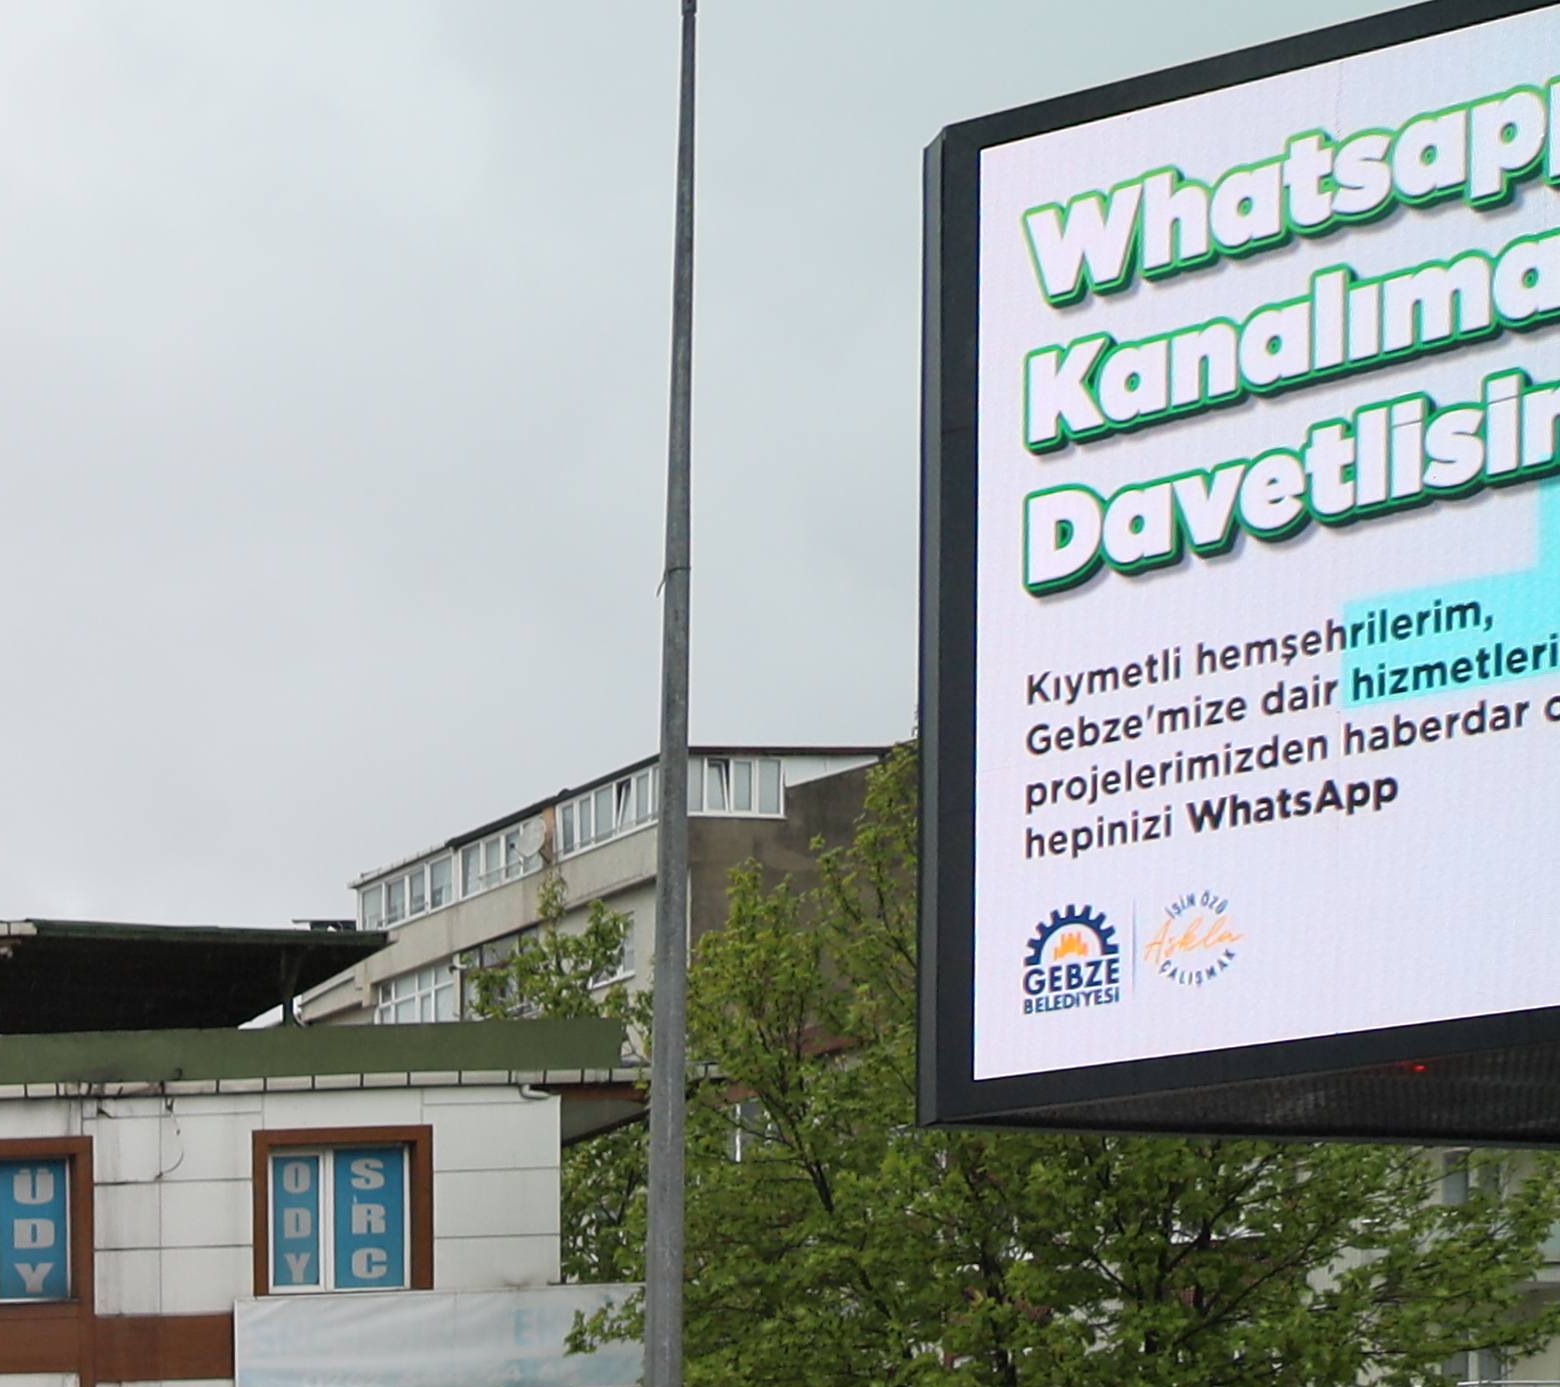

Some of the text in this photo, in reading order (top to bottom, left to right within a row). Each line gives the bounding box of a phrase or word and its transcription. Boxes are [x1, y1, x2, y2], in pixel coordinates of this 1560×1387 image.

[1022, 77, 1560, 303] Whatsap
[1026, 598, 1494, 706] Kıymetli hemşehrilerim,
[1026, 694, 1248, 756] Gebze'mize
[1262, 675, 1338, 717] dair
[1026, 734, 1328, 814] projelerimizden
[1343, 699, 1530, 756] haberdar
[1026, 775, 1398, 860] hepinizi WhatsApp
[1023, 957, 1120, 995] GEBZE
[1023, 987, 1120, 1015] BELEDİYESİ
[13, 1168, 55, 1294] ÜDY
[351, 1158, 388, 1280] SRC
